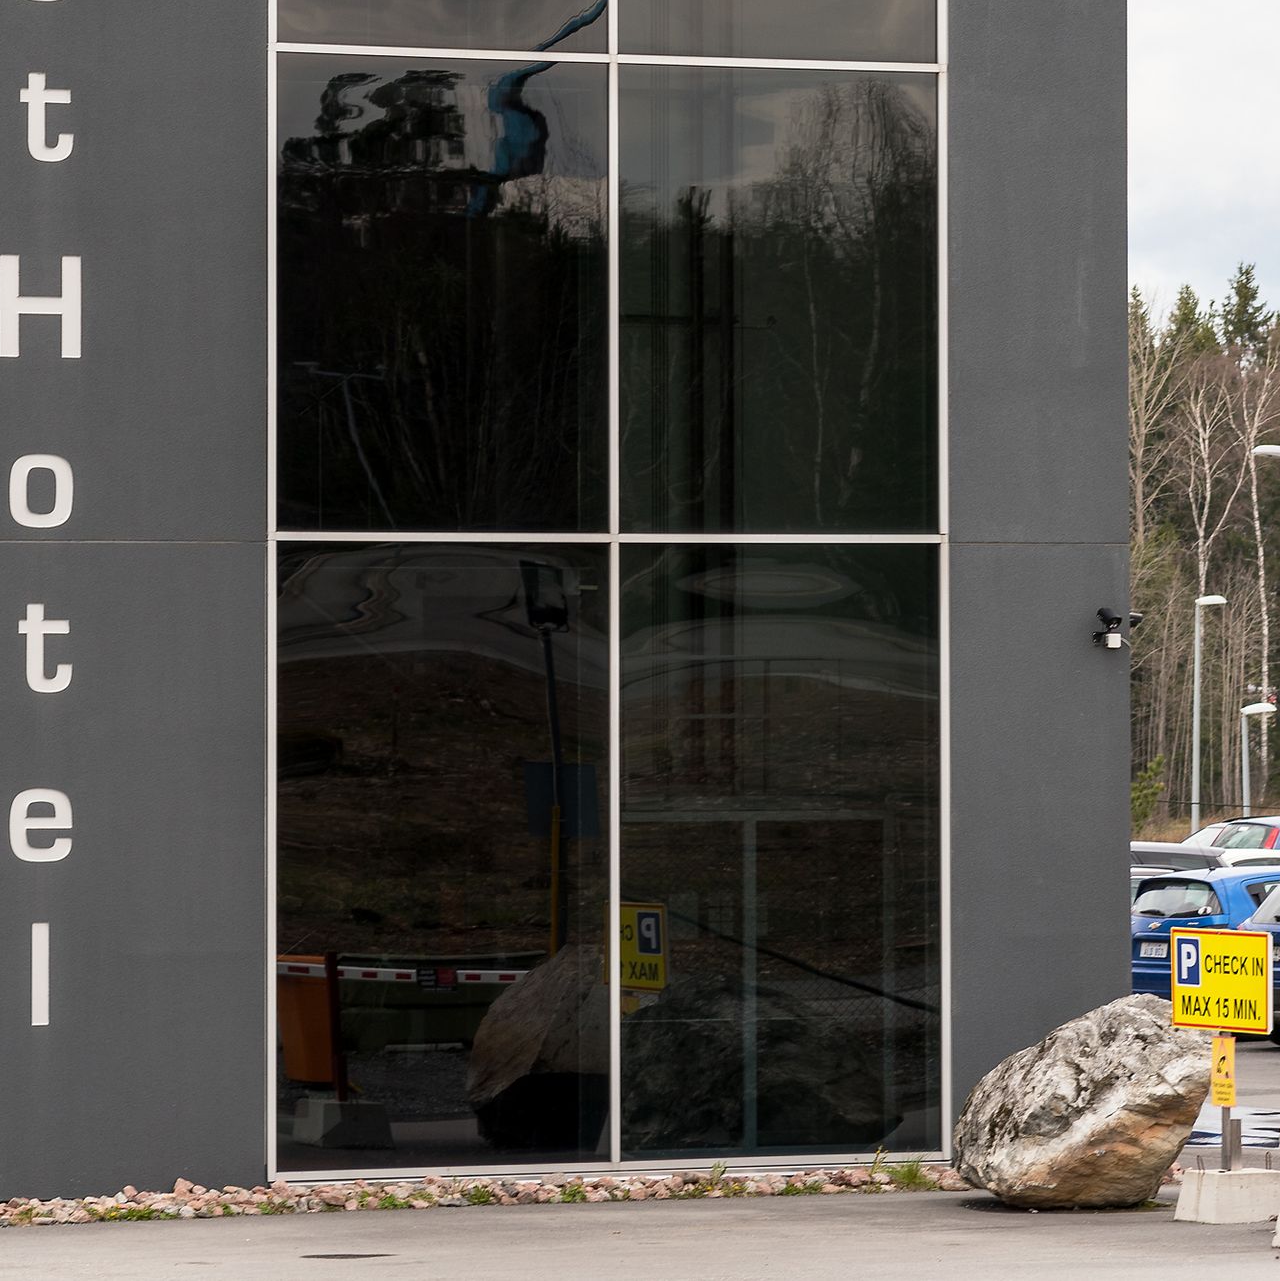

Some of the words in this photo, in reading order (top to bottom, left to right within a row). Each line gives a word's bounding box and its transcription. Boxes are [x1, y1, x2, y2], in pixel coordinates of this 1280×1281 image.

[1181, 943, 1197, 979] P
[1204, 954, 1248, 975] CHECK
[1252, 957, 1264, 976] IN
[1181, 994, 1211, 1017] MAX
[1215, 998, 1229, 1018] 15
[1233, 999, 1261, 1021] MIN.
